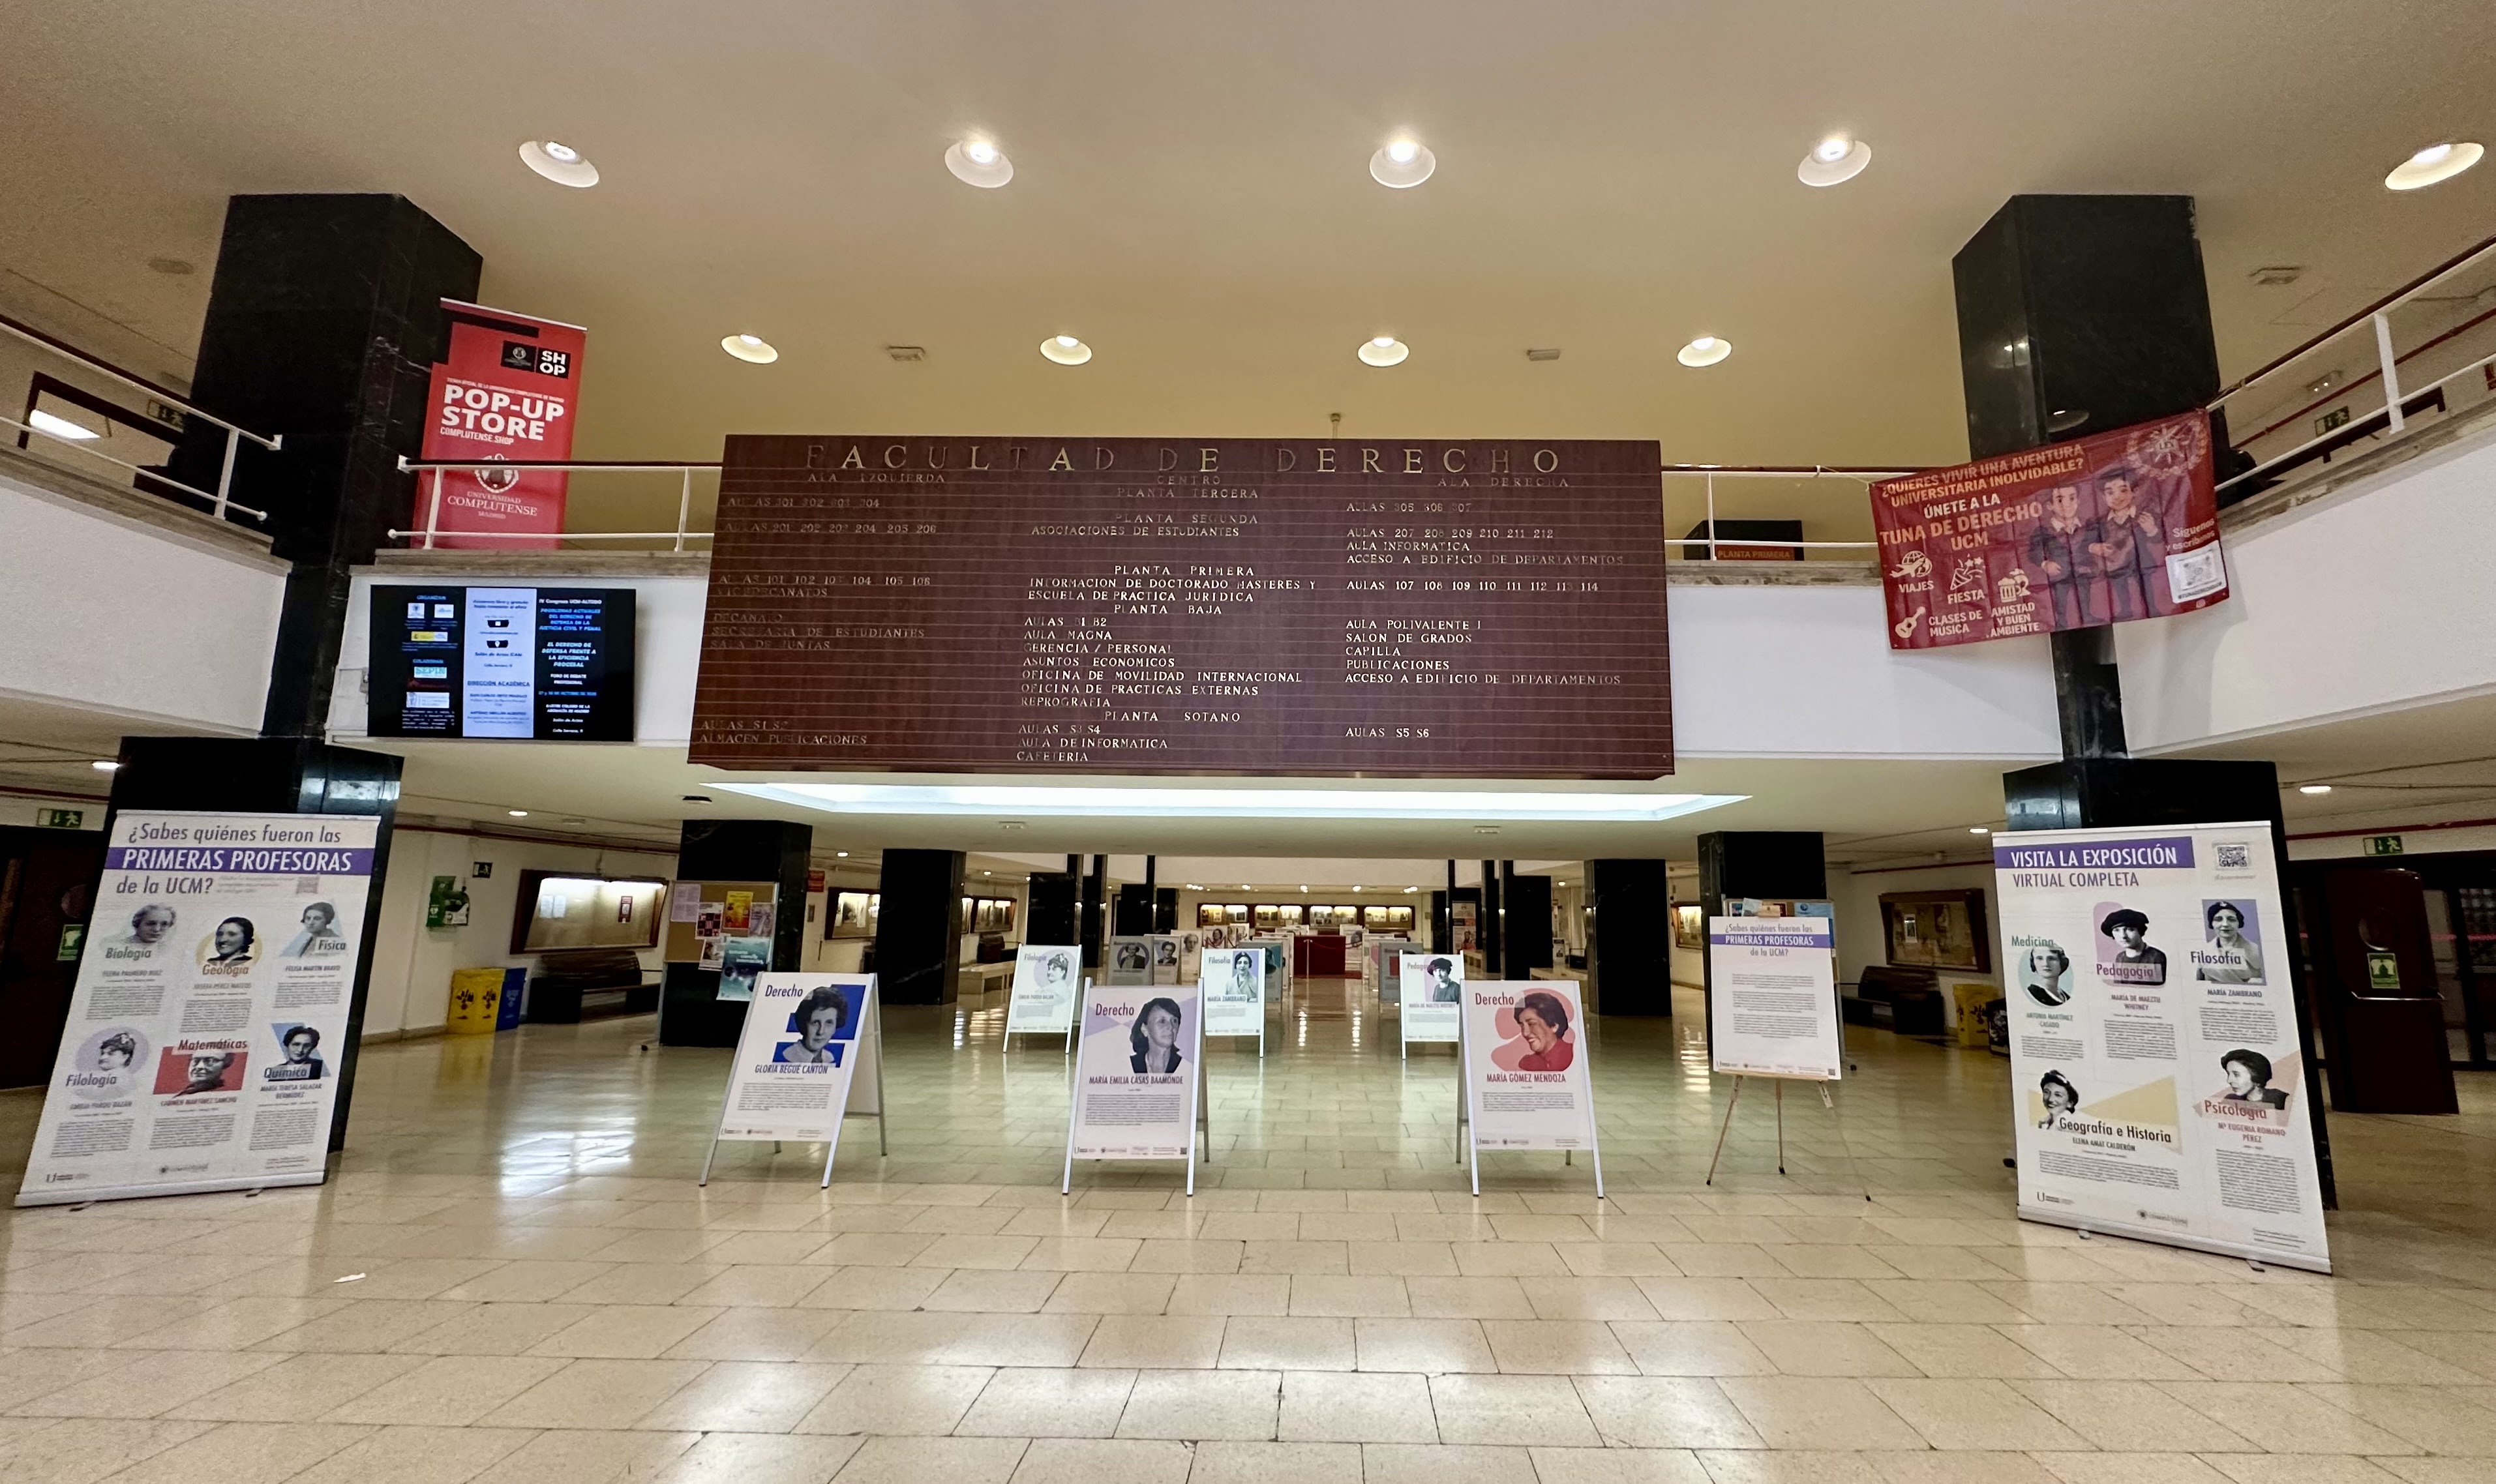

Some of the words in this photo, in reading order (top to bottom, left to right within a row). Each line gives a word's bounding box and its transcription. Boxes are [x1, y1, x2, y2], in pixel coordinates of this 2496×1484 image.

[542, 350, 565, 364] SH
[539, 363, 565, 375] OP
[444, 384, 564, 422] POP-UP
[442, 406, 545, 440] STORE
[805, 445, 1115, 471] FACULTAD
[1158, 448, 1219, 472] DE
[1276, 448, 1559, 473] DERECHO
[1882, 475, 1939, 497] ¿QUIERES
[1980, 460, 2009, 475] UNA
[2011, 444, 2084, 469] AVENTURA
[1891, 479, 1987, 507] UNIVERSITARIA
[1990, 458, 2084, 488] INOLVIDABLE?
[467, 491, 521, 504] UNIVERSIDAD
[447, 496, 537, 516] COMPLUTENSE
[1924, 499, 1968, 519] ÚNETE
[1970, 497, 1980, 510] A
[1983, 493, 2000, 507] LA
[1880, 525, 1926, 546] TUNA
[1931, 519, 1953, 537] DE
[1957, 502, 2043, 533] DERECHO
[1032, 526, 1125, 535] ASOCIACIONES
[1134, 526, 1149, 536] DE
[1158, 527, 1239, 537] ESTUDIANTES
[1347, 529, 1385, 537] AULAS
[1452, 529, 1472, 538] 209
[1479, 529, 1499, 538] 210
[1507, 529, 1525, 539] 211
[1534, 529, 1554, 539] 212
[1951, 531, 1988, 551] UCM
[1115, 565, 1171, 575] PLANTA
[1190, 565, 1254, 576] PRIMERA
[1347, 581, 1385, 590] AULAS
[1396, 581, 1413, 590] 107
[1424, 581, 1443, 590] 108
[1452, 581, 1470, 591] 109
[1479, 582, 1496, 591] 110
[1507, 582, 1522, 591] 111
[1531, 582, 1547, 591] 112
[1581, 582, 1599, 591] 114
[1899, 580, 1934, 593] VIAJES
[1029, 591, 1085, 601] ESCUELA
[1093, 591, 1108, 601] DE
[1113, 591, 1175, 601] PRACTICA
[1185, 592, 1254, 602] JURIDICA
[1947, 589, 1985, 604] FIESTA
[1991, 602, 2035, 617] AMISTAD
[1929, 612, 1966, 626] CLASES
[1969, 610, 1983, 621] DE
[1997, 617, 2004, 626] Y
[2006, 614, 2031, 625] BUEN
[1346, 620, 1377, 629] AULA
[1387, 620, 1469, 630] POLIVALENTE
[1991, 623, 2039, 637] AMBIENTE
[1025, 631, 1055, 640] AULA
[1068, 631, 1112, 640] MAGNA
[1346, 634, 1387, 642] SALON
[1398, 634, 1413, 642] DE
[1421, 634, 1472, 644] GRADOS
[1025, 644, 1089, 653] GERENCIA
[1108, 644, 1172, 654] PERSONAL
[1346, 647, 1401, 656] CAPILLA
[1023, 657, 1079, 666] ASUNTOS
[1093, 658, 1175, 667] ECONOMICOS
[1346, 660, 1449, 670] PUBLICACIONES
[1022, 671, 1080, 680] OFICINA
[1089, 671, 1104, 680] DE
[1115, 672, 1185, 681] MOVILIDAD
[1197, 672, 1302, 682] INTERNACIONAL
[1346, 674, 1393, 683] ACCESO
[1400, 675, 1409, 683] A
[1416, 674, 1478, 684] EDIFICIO
[1485, 675, 1500, 684] DE
[1512, 675, 1621, 685] DEPARTAMENTOS
[1021, 684, 1079, 693] OFICINA
[1085, 684, 1102, 694] DE
[1112, 685, 1182, 694] PRACTICAS
[1192, 686, 1259, 696] EXTERNAS
[1021, 697, 1110, 707] REPROGRAFIA
[1346, 728, 1385, 737] AULAS
[1396, 728, 1410, 737] S5
[1417, 728, 1430, 738] S6
[1017, 752, 1088, 762] CAFETERIA
[128, 822, 188, 844] ¿Sabes
[194, 825, 256, 844] quiénes
[263, 824, 313, 842] fueron
[319, 825, 341, 843] las
[123, 849, 224, 870] PRIMERAS
[230, 850, 352, 871] PROFESORAS
[2011, 850, 2055, 867] VISITA
[2060, 850, 2078, 867] LA
[2084, 844, 2177, 867] EXPOSICIÓN
[116, 879, 136, 894] de
[143, 876, 158, 893] la
[166, 877, 213, 894] UCM?
[2013, 873, 2065, 887] VIRTUAL
[2069, 872, 2139, 887] COMPLETA
[1726, 923, 1748, 933] ¿Sabes
[1778, 923, 1800, 932] fueron
[1803, 924, 1812, 932] las
[1725, 935, 1762, 944] PRIMERAS
[1765, 936, 1813, 945] PROFESORAS
[2011, 935, 2054, 947] Medicina
[105, 946, 152, 960] Biología
[1751, 947, 1758, 956] de
[1769, 948, 1788, 957] UCM?
[2191, 951, 2242, 964] Filosofía
[202, 964, 249, 977] Geología
[2096, 964, 2154, 979] Pedagogía
[765, 984, 803, 997] Derecho
[1475, 992, 1514, 1005] Derecho
[1096, 1002, 1134, 1016] Derecho
[178, 1038, 248, 1052] Matemáticas
[755, 1064, 777, 1074] GLORIA
[66, 1075, 117, 1088] Filología
[1089, 1075, 1107, 1084] MARÍA
[1109, 1076, 1129, 1084] EMILIA
[1131, 1076, 1149, 1084] CASAS
[1150, 1076, 1183, 1084] BAAMONDE
[1486, 1073, 1507, 1082] MARÍA
[1509, 1072, 1532, 1082] GÓMEZ
[1534, 1073, 1566, 1082] MENDOZA
[2204, 1100, 2267, 1120] Psicología
[2060, 1117, 2113, 1135] Geografía
[2117, 1128, 2123, 1136] e
[2127, 1125, 2171, 1143] Historia
[2229, 1123, 2255, 1133] EUGENIA
[2257, 1127, 2286, 1136] ROMANO
[2107, 1142, 2135, 1151] CALDERÓN
